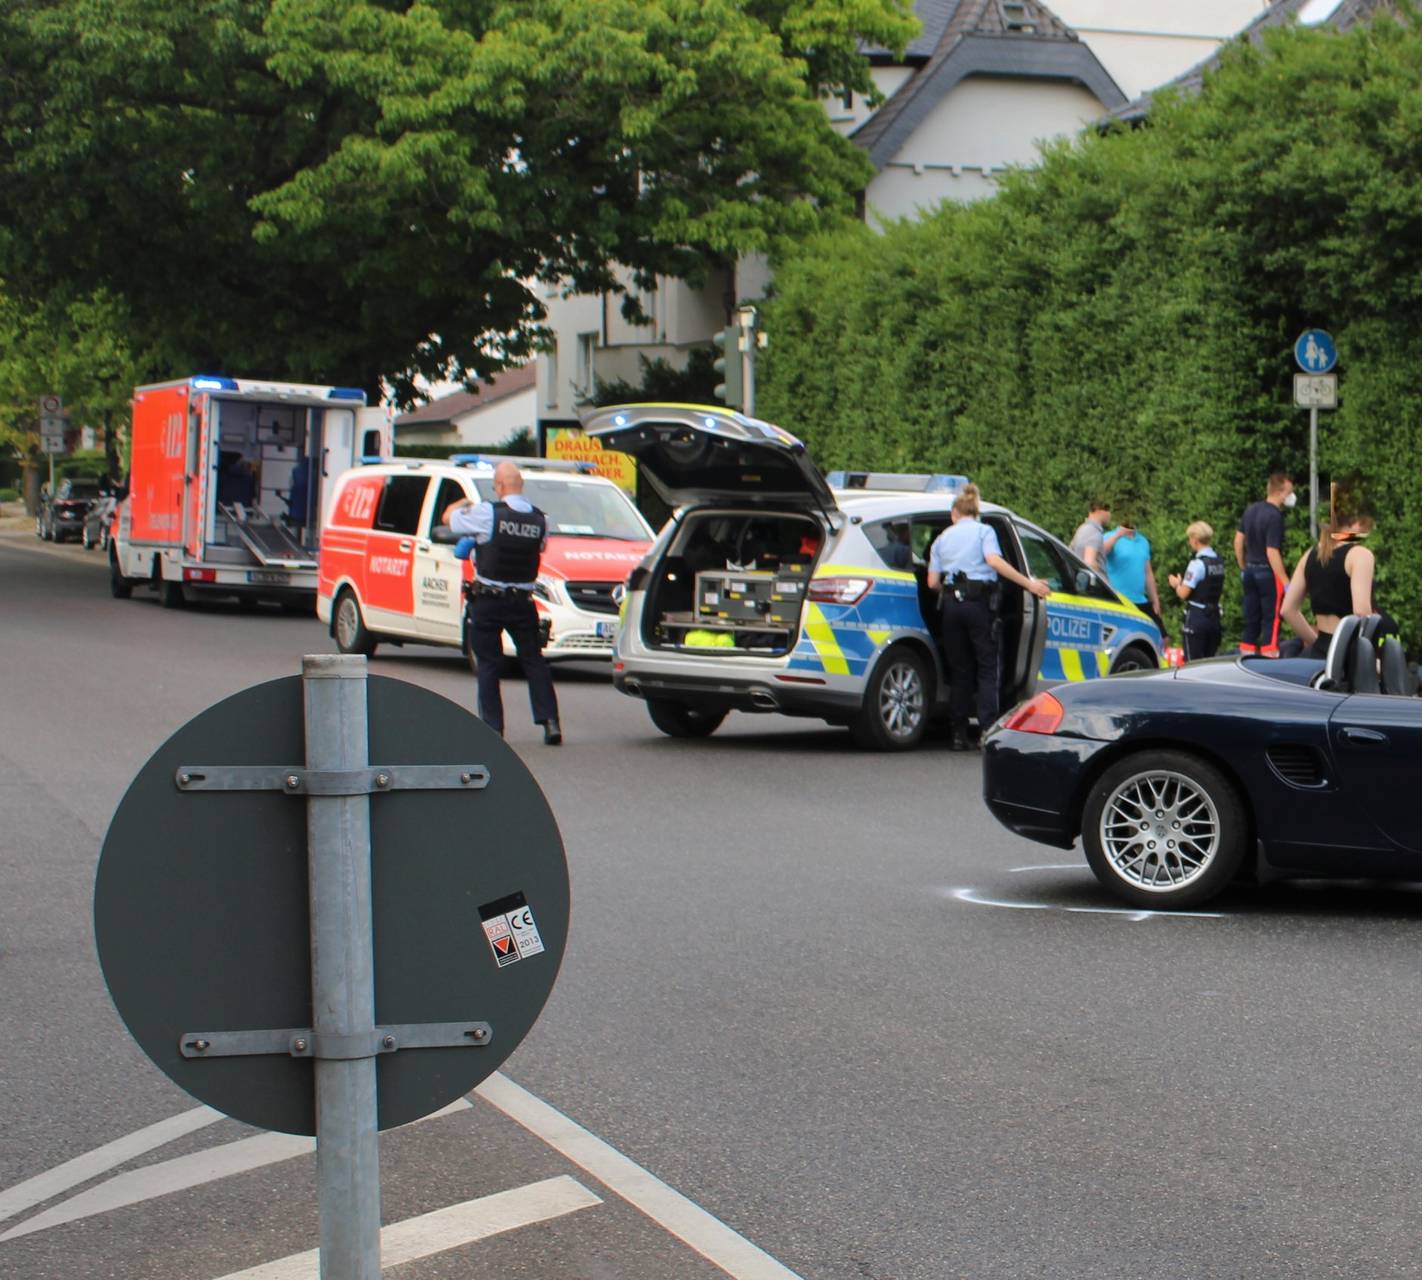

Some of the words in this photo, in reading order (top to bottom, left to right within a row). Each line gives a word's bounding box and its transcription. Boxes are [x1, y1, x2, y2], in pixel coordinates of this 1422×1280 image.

[555, 436, 603, 453] DRAUS
[499, 520, 541, 538] POLIZEI
[369, 555, 409, 577] NOTARZT
